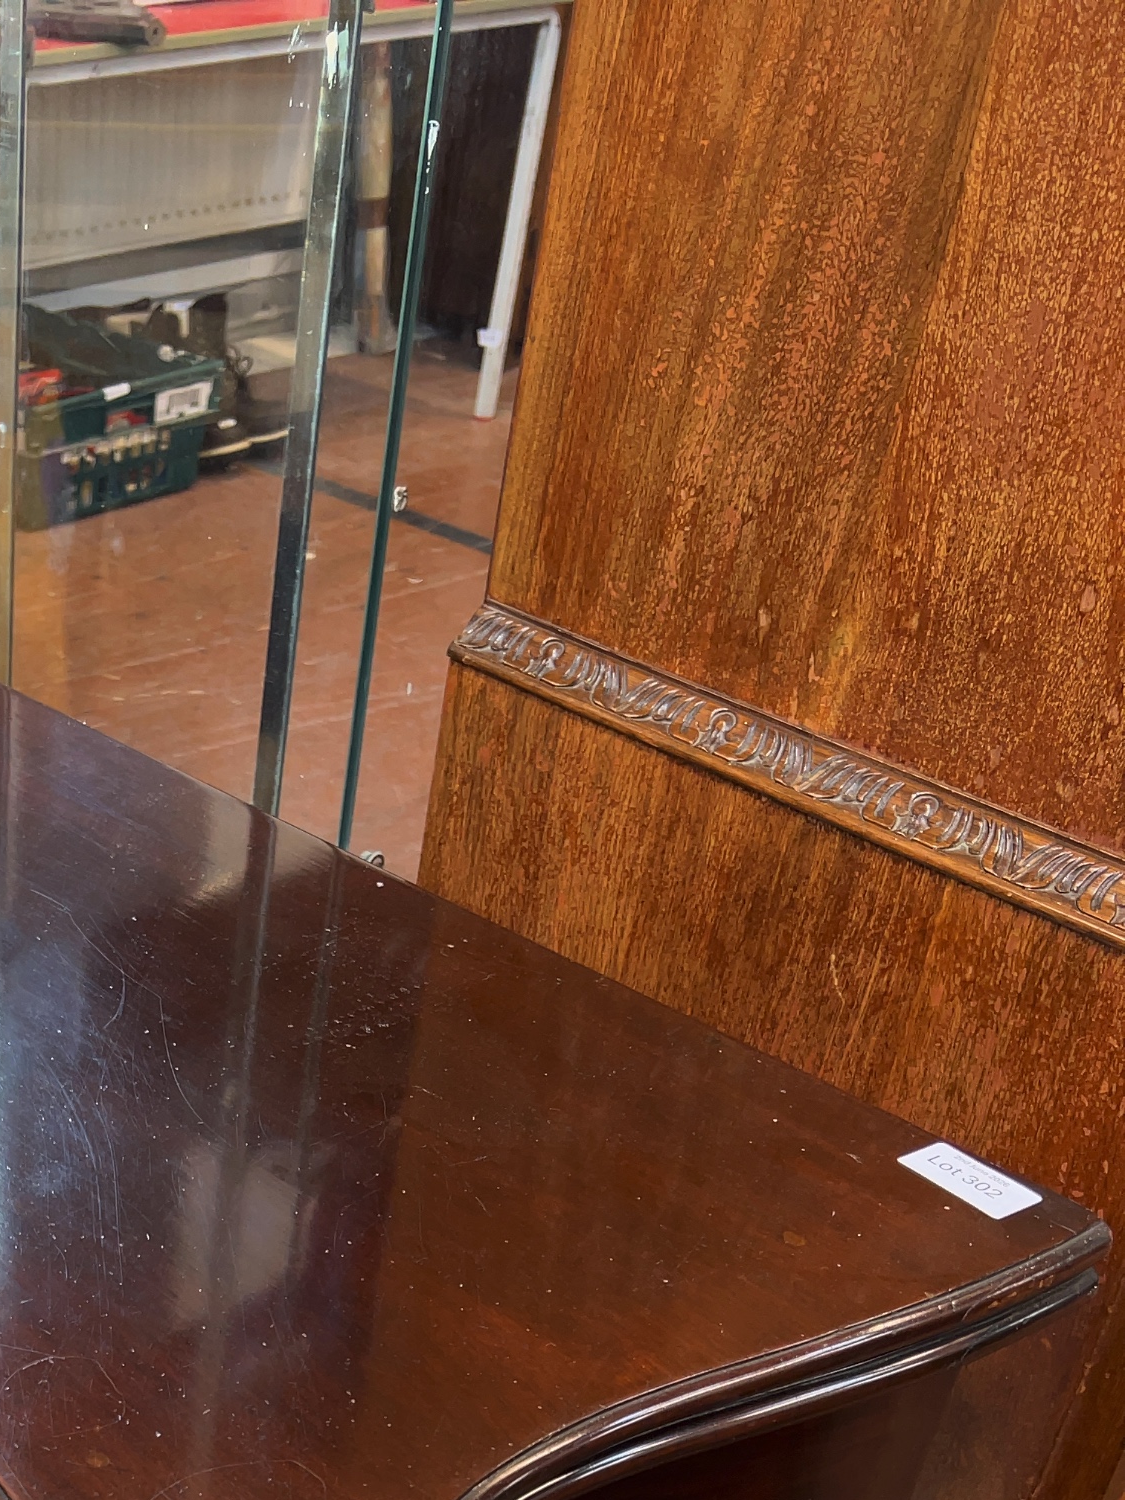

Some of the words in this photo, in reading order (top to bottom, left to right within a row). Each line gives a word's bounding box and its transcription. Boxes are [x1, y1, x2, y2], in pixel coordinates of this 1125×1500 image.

[927, 1155, 963, 1177] Lot
[961, 1175, 1003, 1200] 302
[969, 1162, 989, 1176] June
